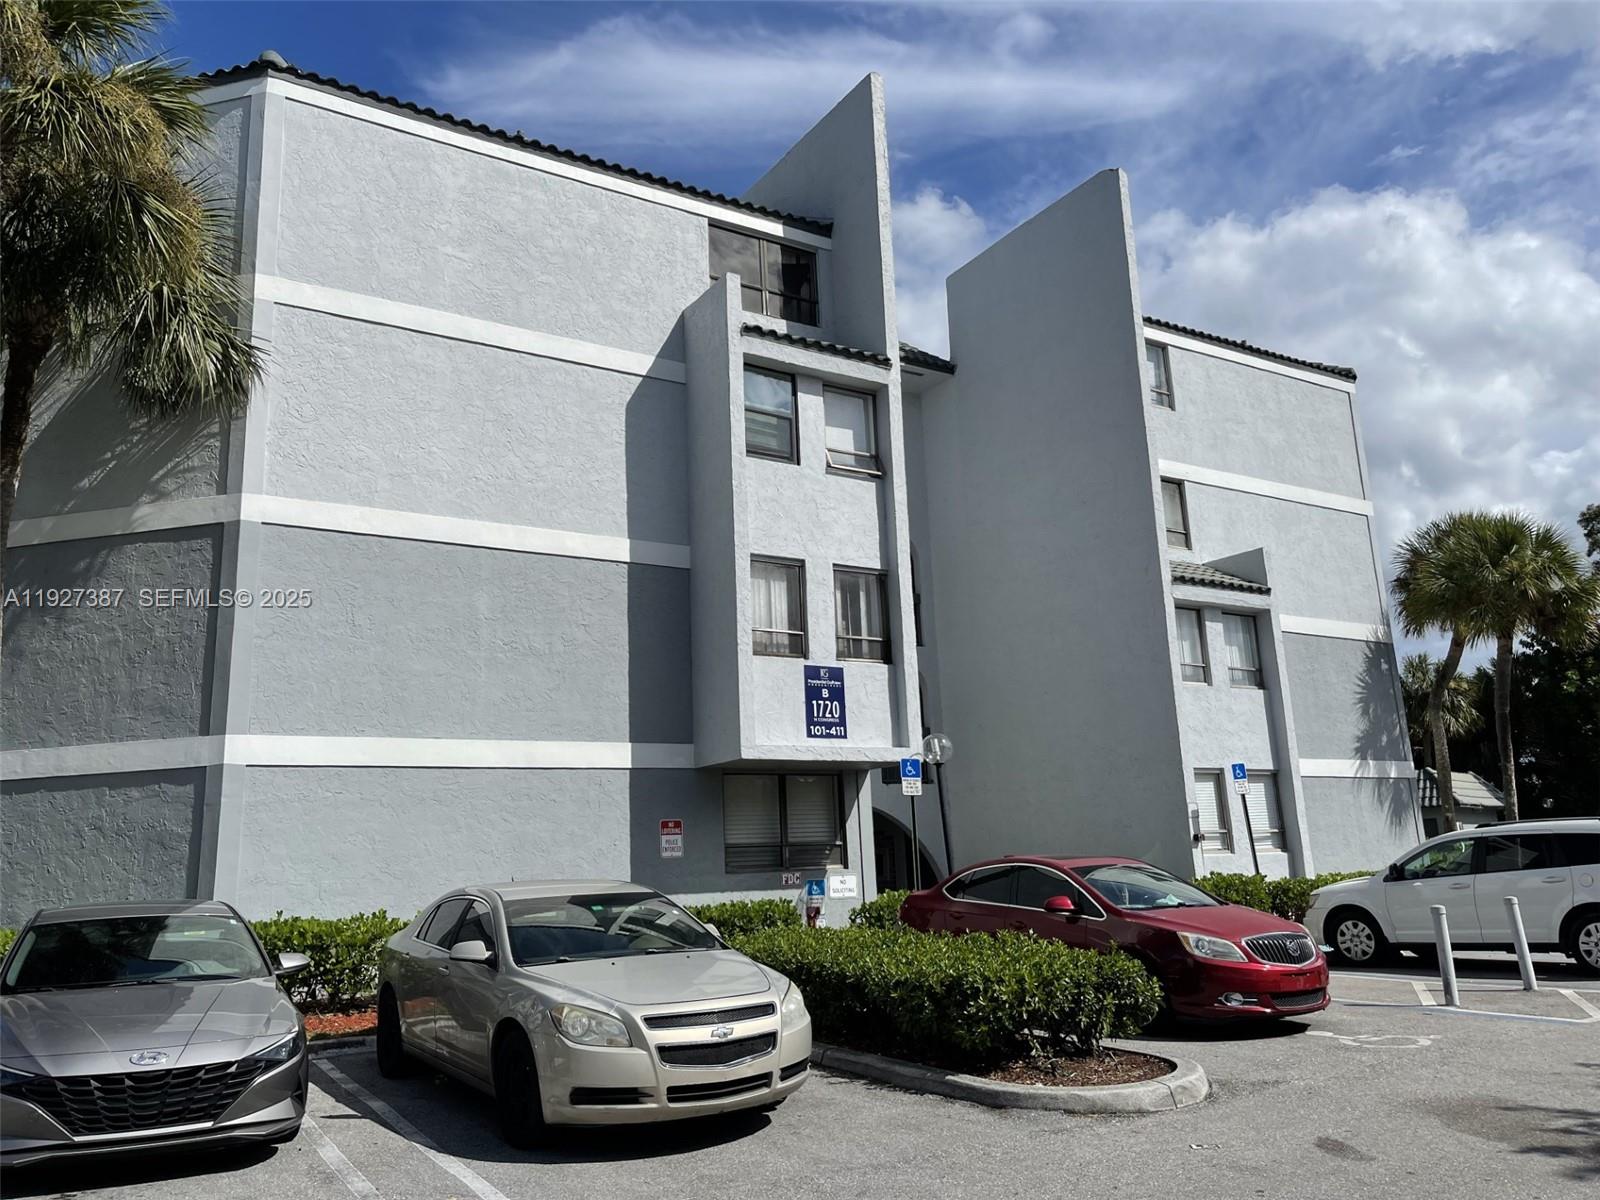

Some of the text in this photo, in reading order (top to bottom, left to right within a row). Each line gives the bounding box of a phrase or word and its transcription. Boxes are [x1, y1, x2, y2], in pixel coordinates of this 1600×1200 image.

[822, 688, 829, 698] B
[812, 700, 840, 718] 1720
[810, 726, 844, 736] 101-411
[782, 872, 800, 885] FDC
